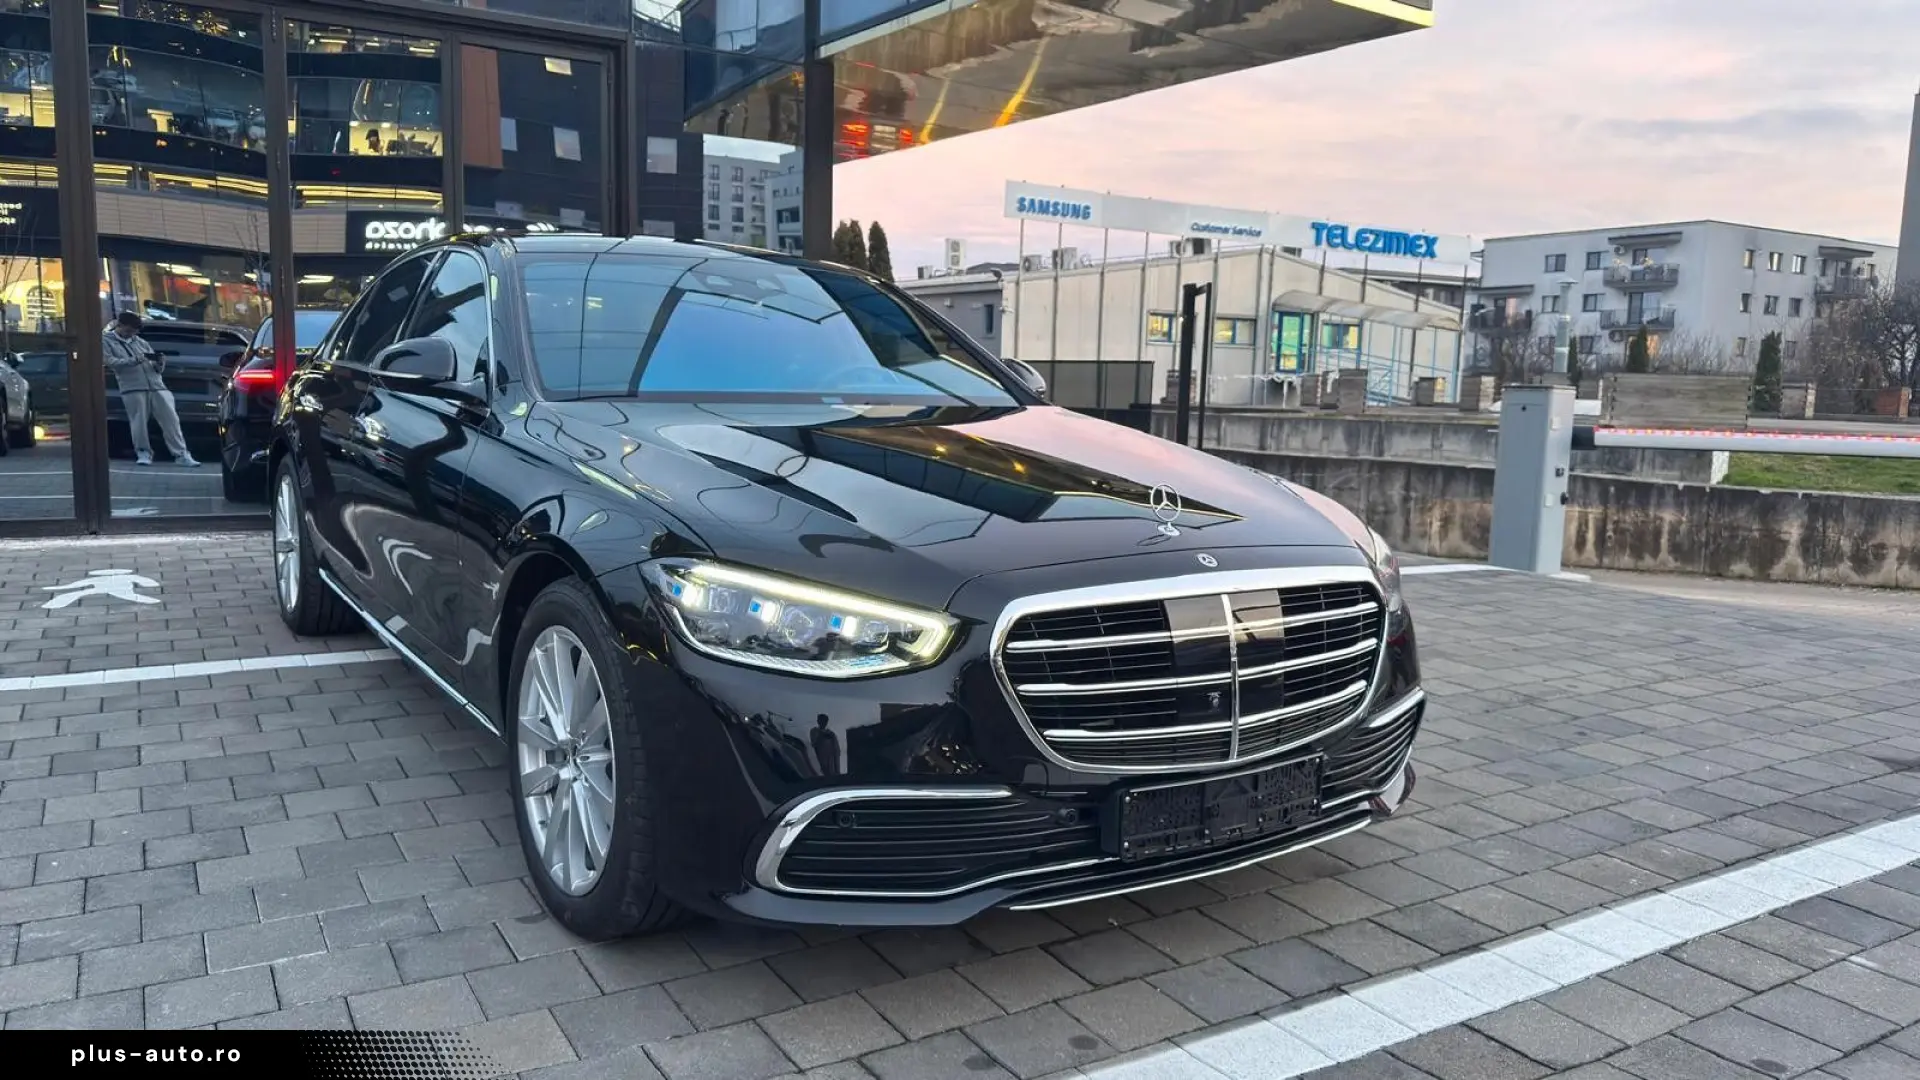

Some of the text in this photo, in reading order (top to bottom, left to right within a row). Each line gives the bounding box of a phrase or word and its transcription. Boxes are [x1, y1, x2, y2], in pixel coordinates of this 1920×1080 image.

[1017, 196, 1092, 220] SAMSUNG
[1190, 222, 1263, 238] Customer Service
[1311, 221, 1438, 259] TELEZIMEX
